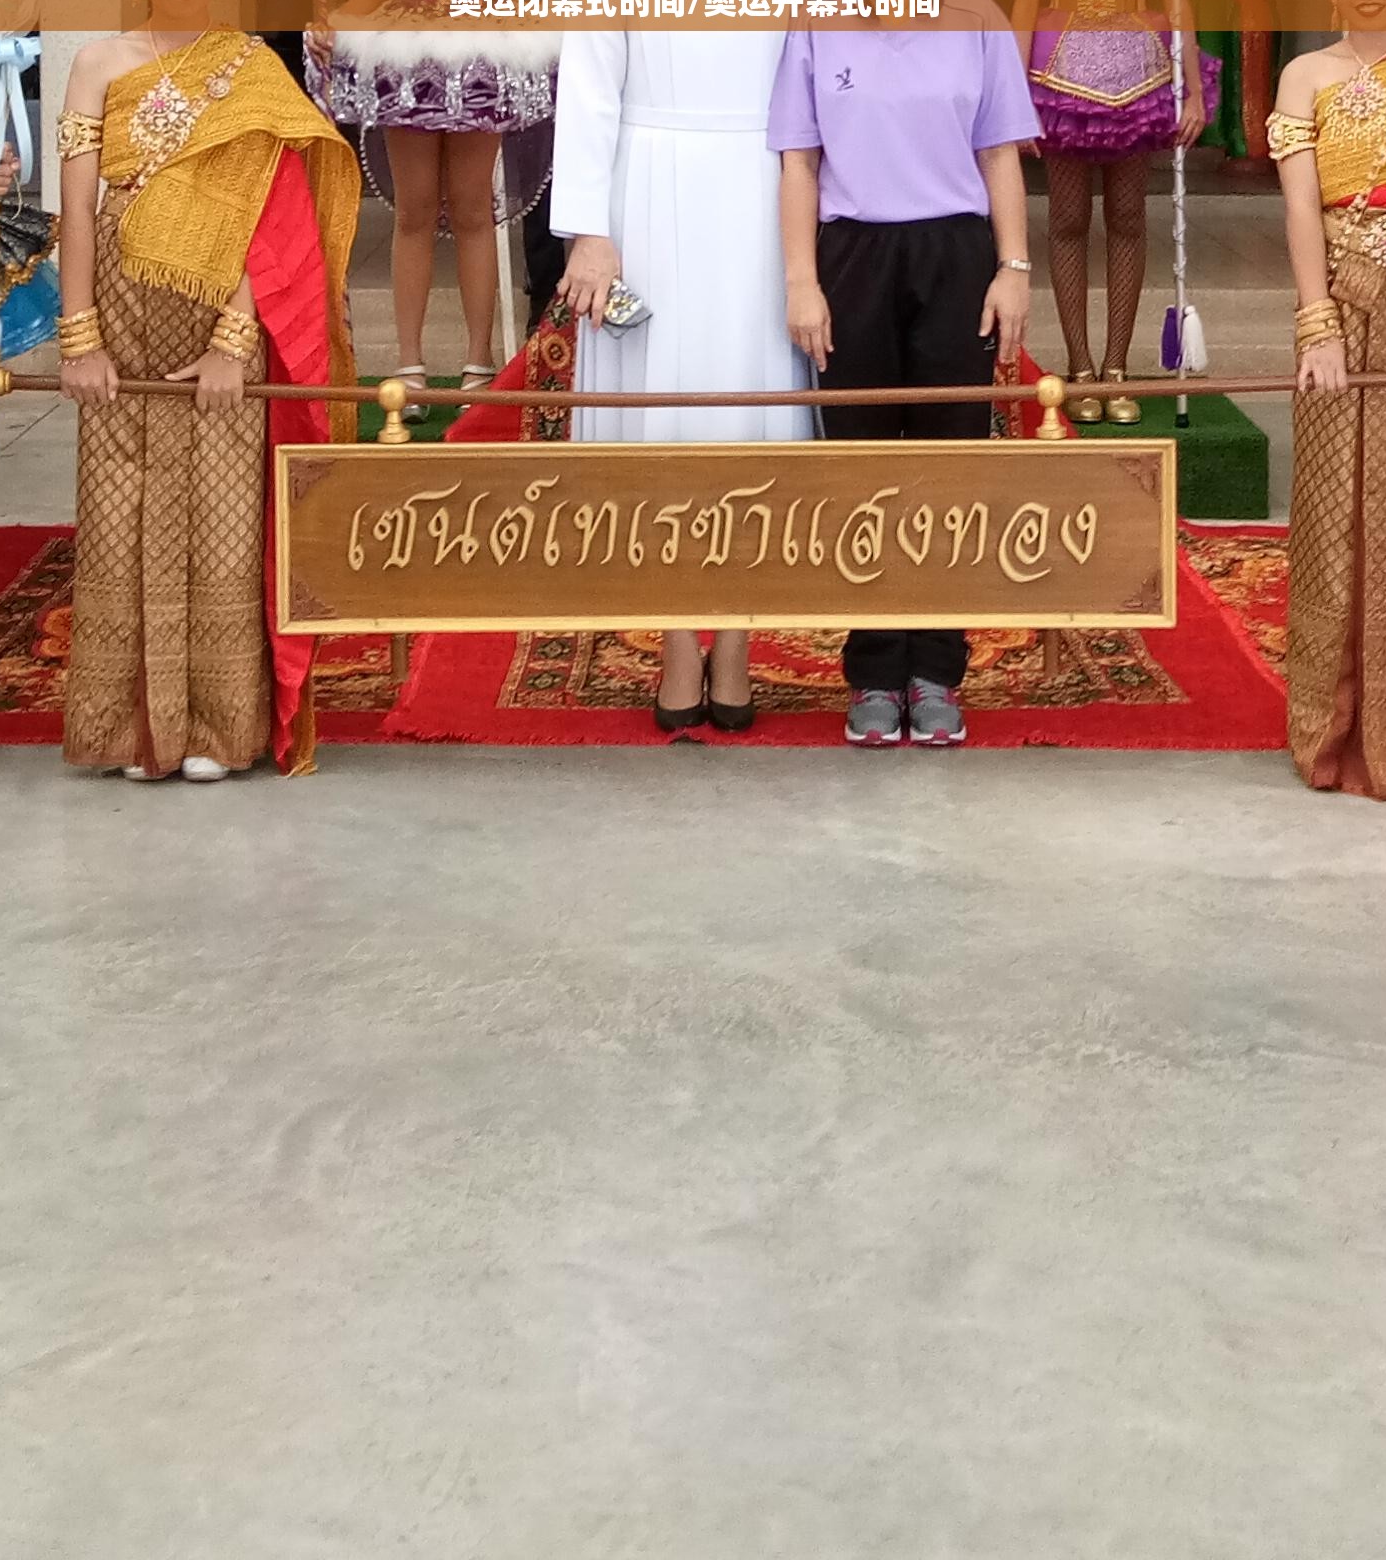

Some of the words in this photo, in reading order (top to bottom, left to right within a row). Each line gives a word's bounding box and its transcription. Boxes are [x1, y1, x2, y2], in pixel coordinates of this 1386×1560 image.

[348, 474, 1097, 584] เซนต์เทเรซาแสงทอง
